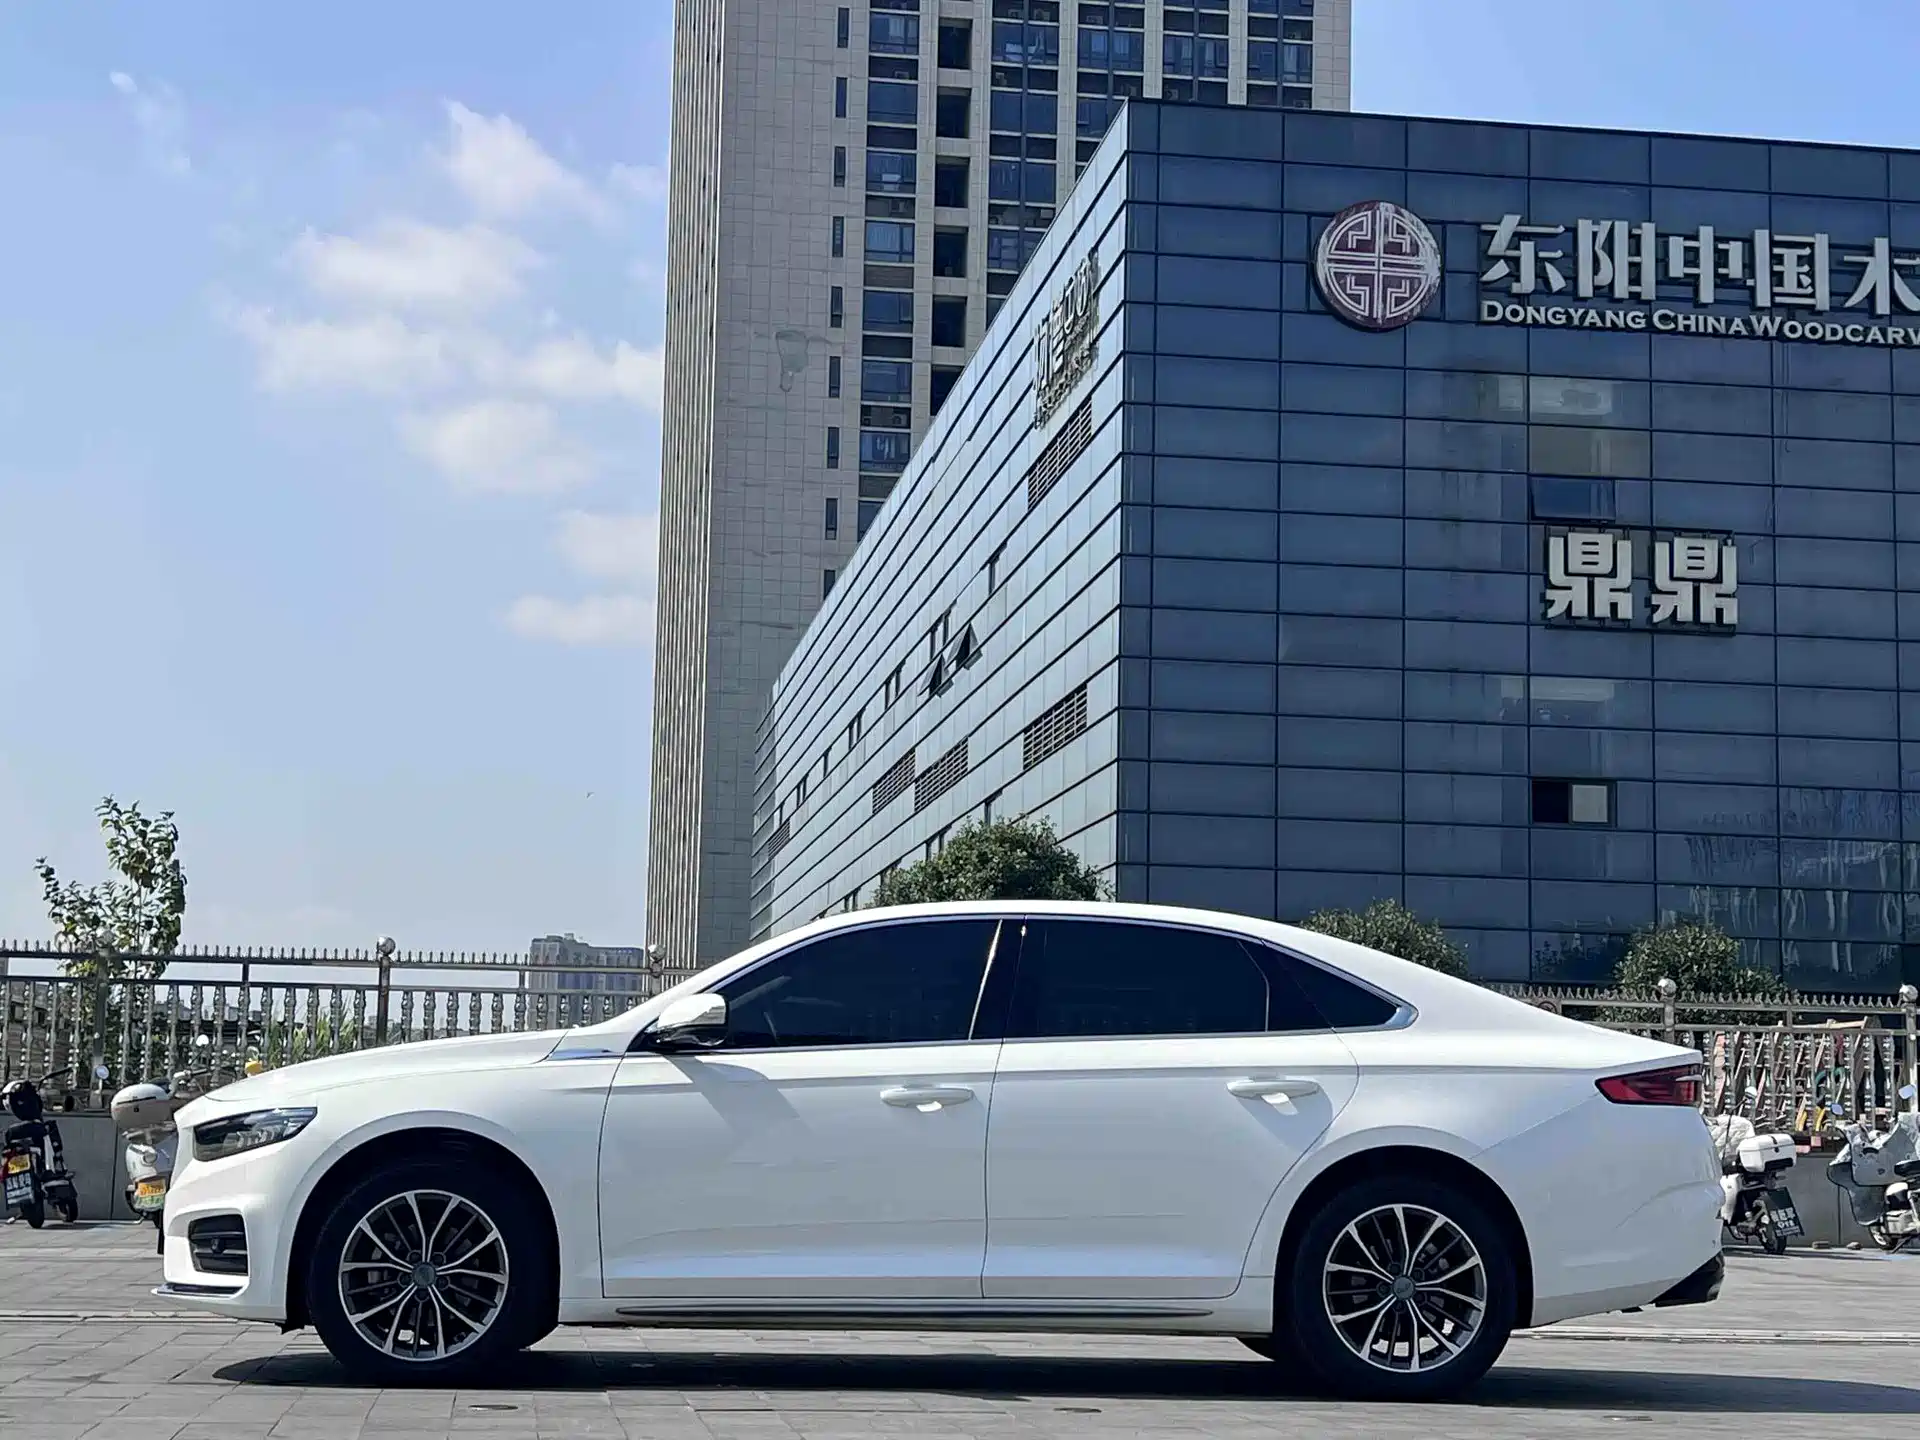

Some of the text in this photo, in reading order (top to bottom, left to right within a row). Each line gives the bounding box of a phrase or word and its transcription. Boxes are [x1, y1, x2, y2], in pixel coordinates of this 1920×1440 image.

[1480, 214, 1920, 315] 东阳中国木
[1480, 301, 1647, 329] DONGYANG
[1546, 532, 1738, 624] 鼎鼎
